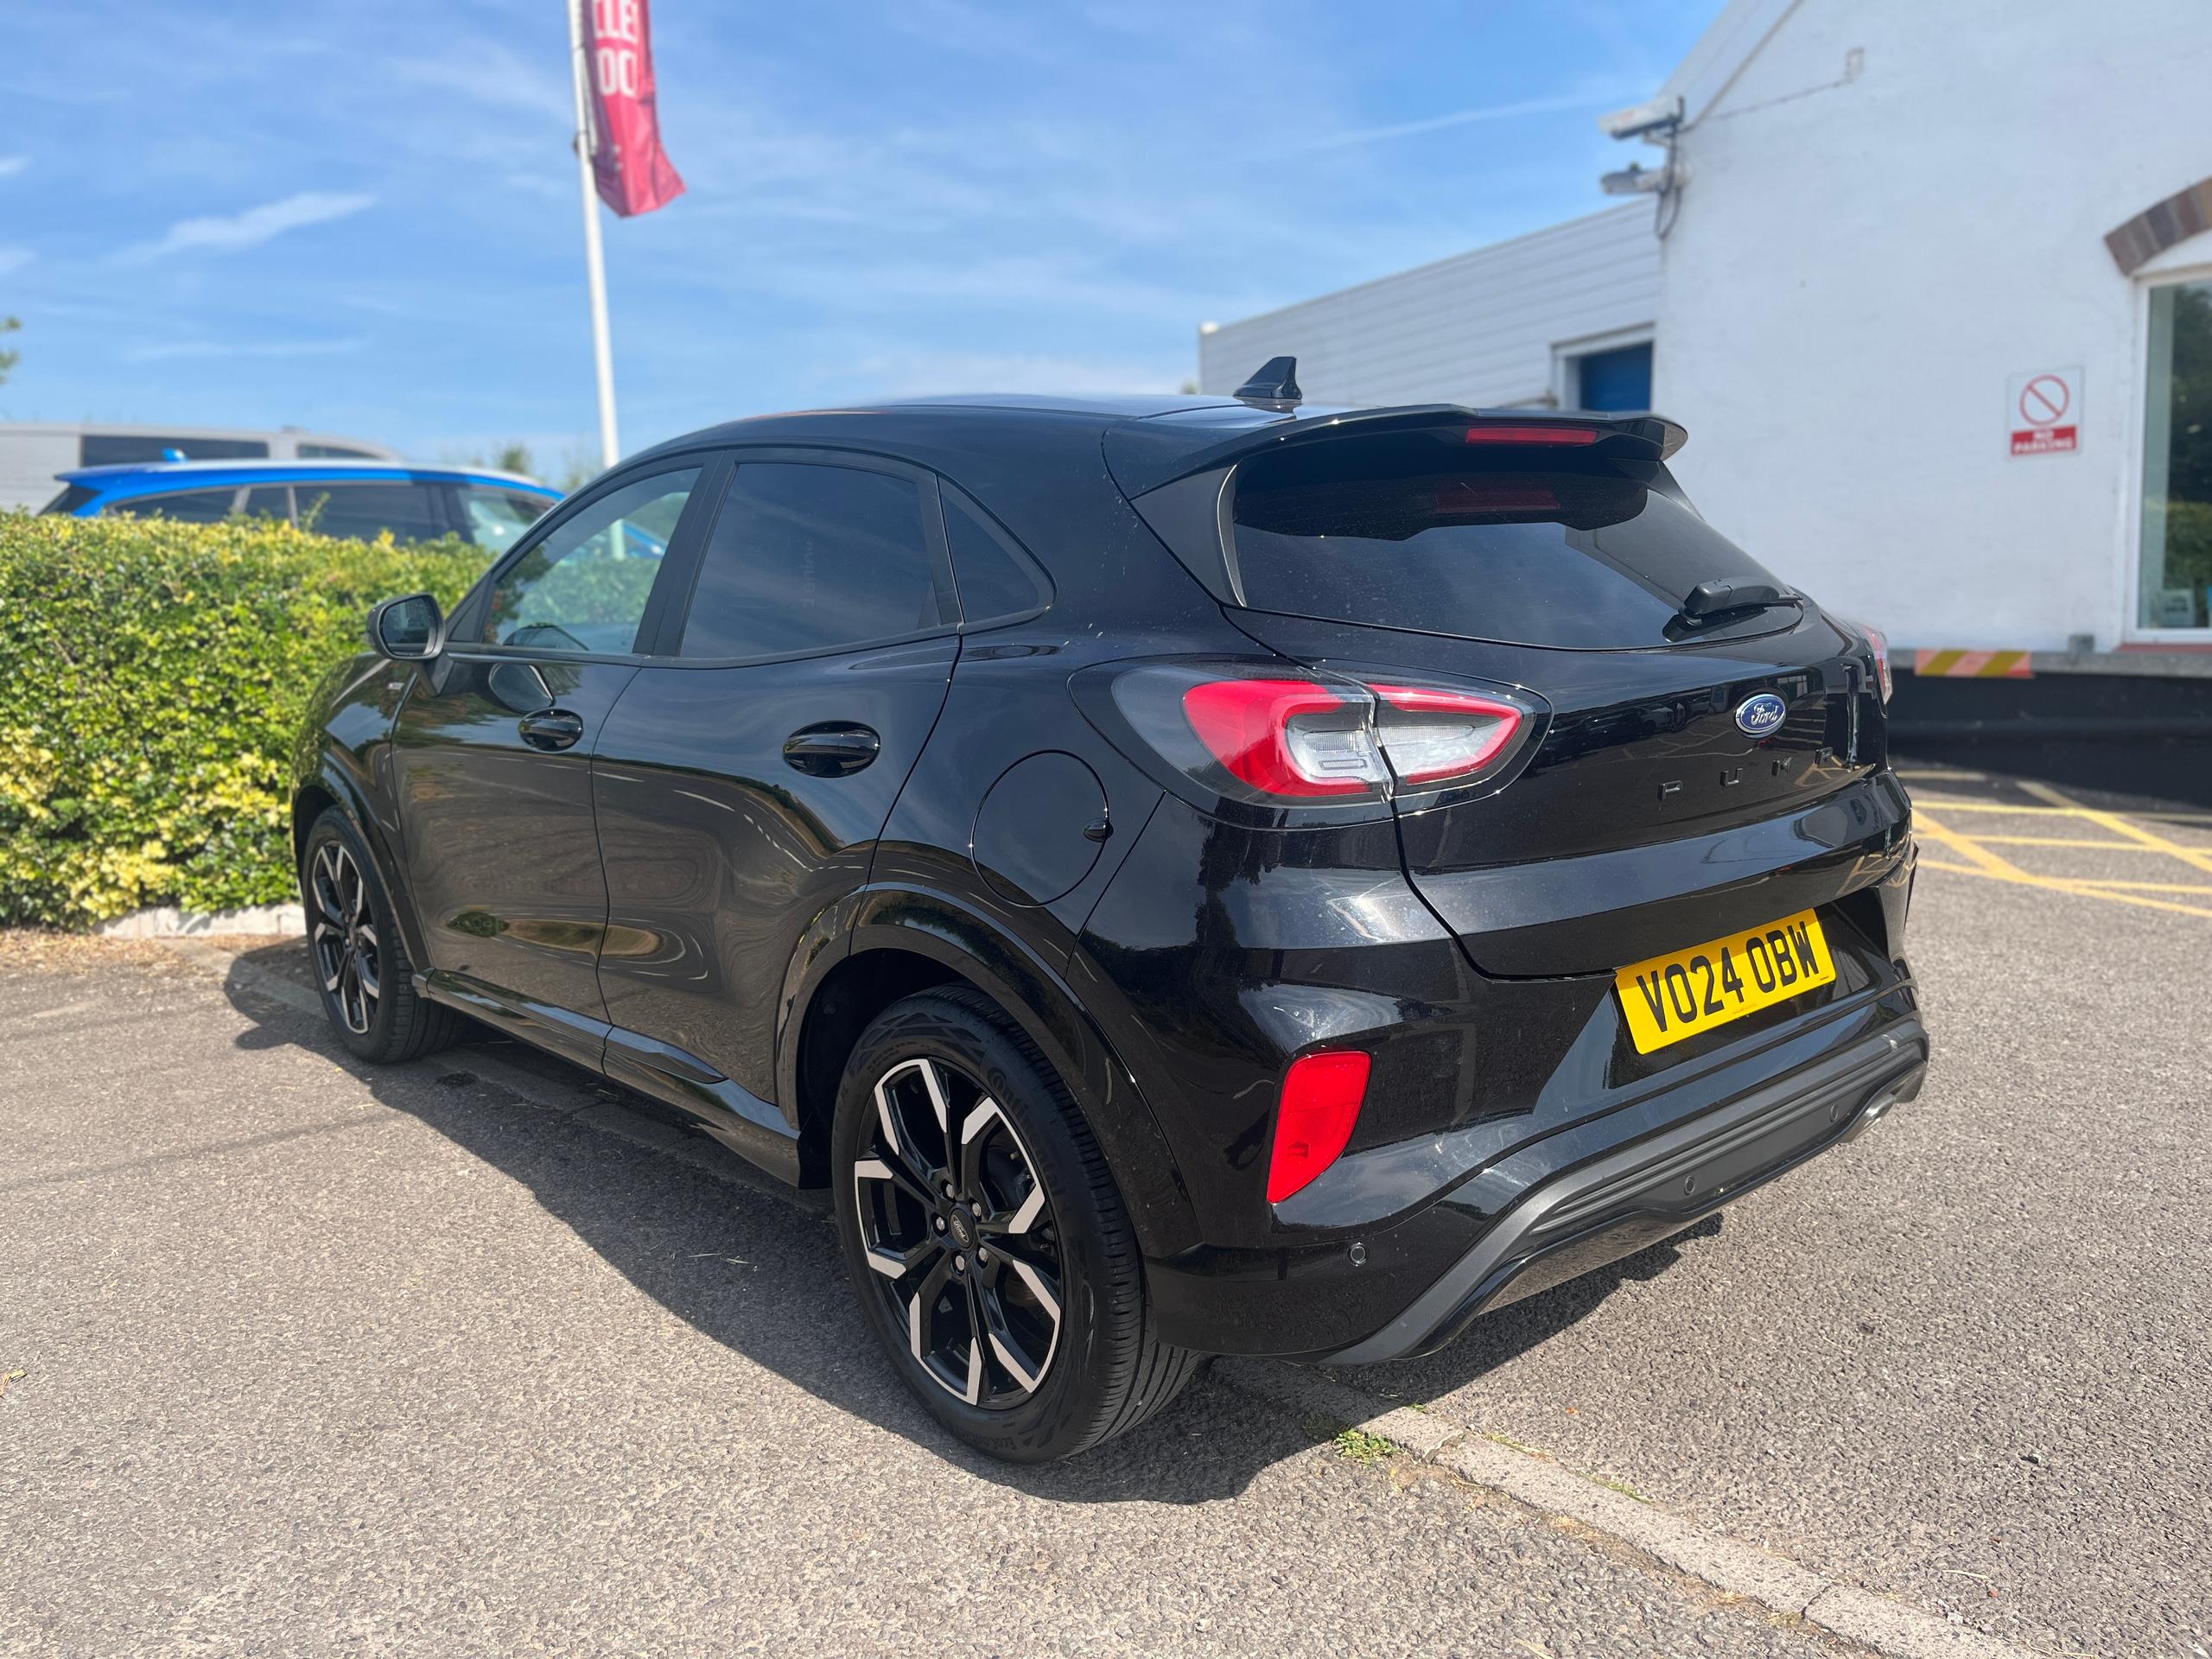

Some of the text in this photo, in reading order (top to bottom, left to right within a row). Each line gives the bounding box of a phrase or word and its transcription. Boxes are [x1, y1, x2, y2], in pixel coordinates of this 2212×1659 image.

[2034, 429, 2054, 442] NO
[2013, 436, 2073, 452] PARKING
[1636, 921, 1819, 1033] VO24 OBW
